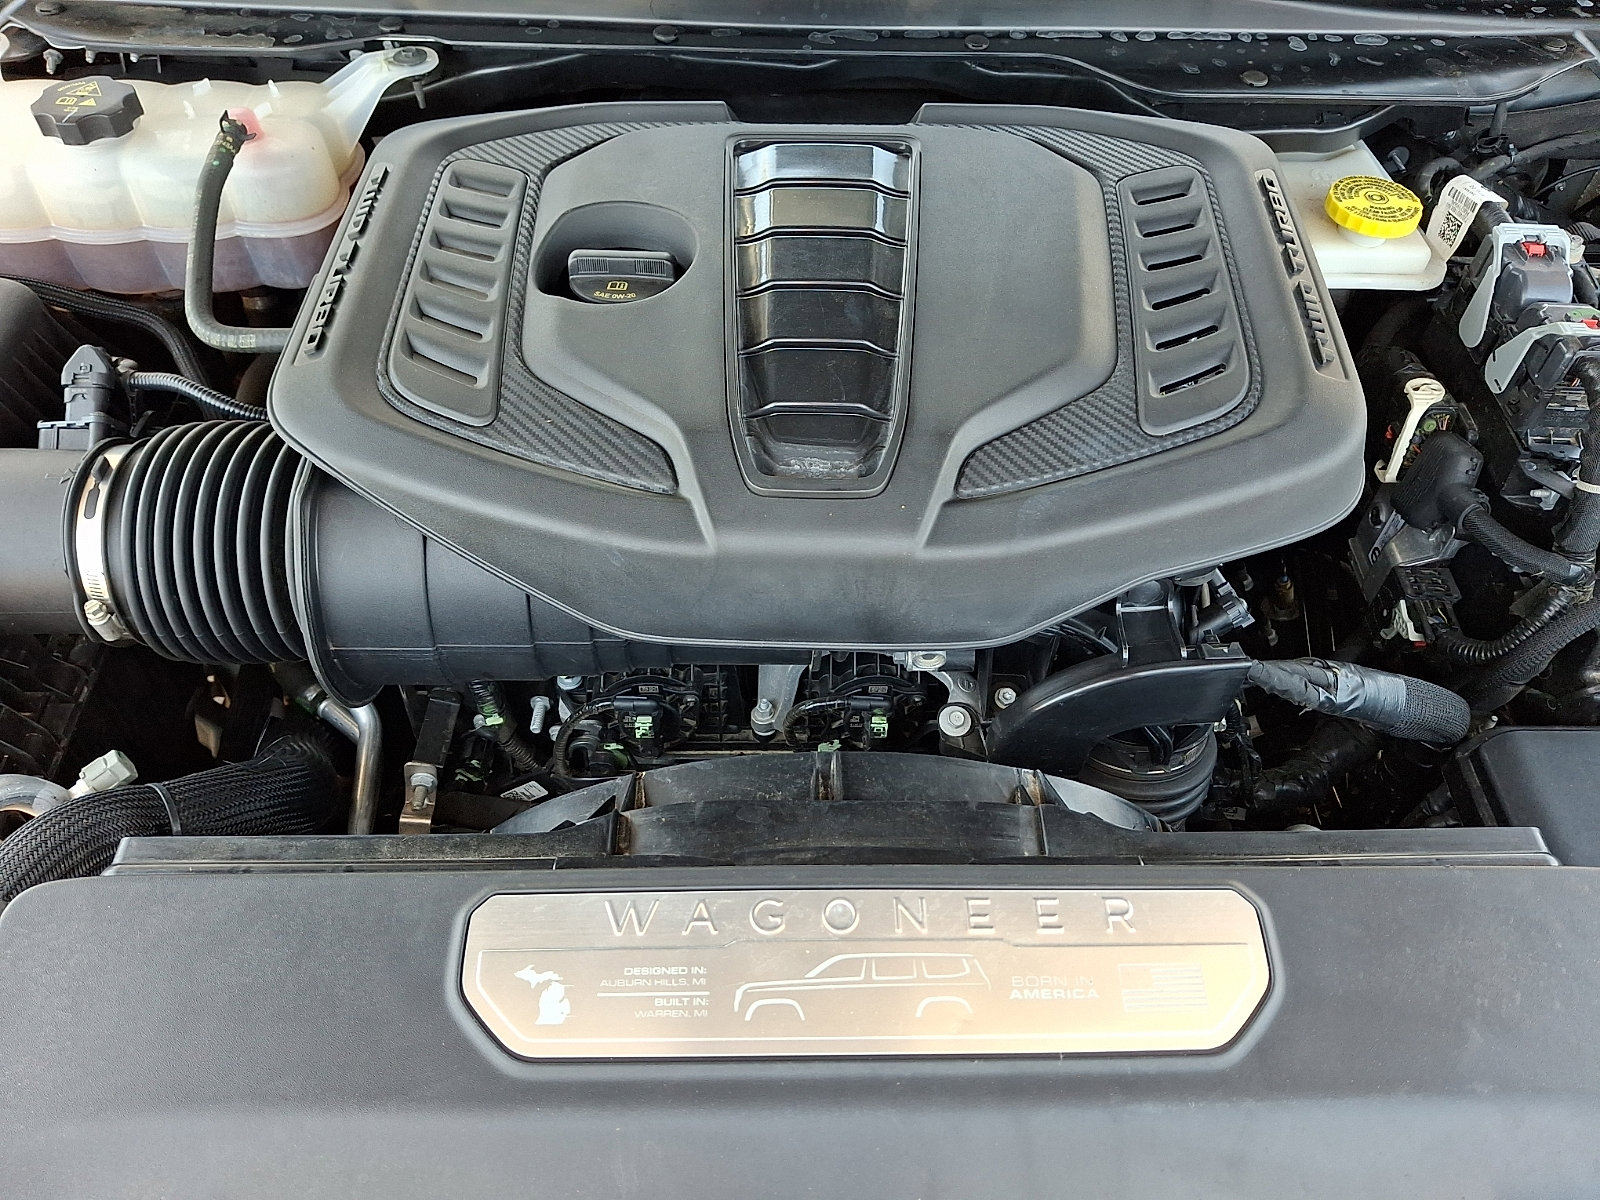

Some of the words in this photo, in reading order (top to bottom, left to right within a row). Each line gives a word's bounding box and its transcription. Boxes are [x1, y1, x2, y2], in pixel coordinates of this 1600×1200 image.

[1259, 174, 1304, 275] TURBO
[304, 241, 361, 355] TURBO
[593, 291, 611, 299] SAE
[603, 896, 1137, 937] WAGONEER
[623, 966, 688, 976] DESIGNED
[691, 966, 708, 975] IN:
[600, 978, 652, 987] AUBURN
[654, 978, 690, 987] HILLS,
[692, 977, 707, 986] MI
[1011, 975, 1067, 987] BORN
[1074, 975, 1095, 987] IN
[1008, 988, 1100, 1000] AMERICA
[654, 998, 690, 1007] BUILT
[693, 998, 709, 1006] IN:
[634, 1010, 692, 1018] WARREN,
[693, 1009, 708, 1017] MI
